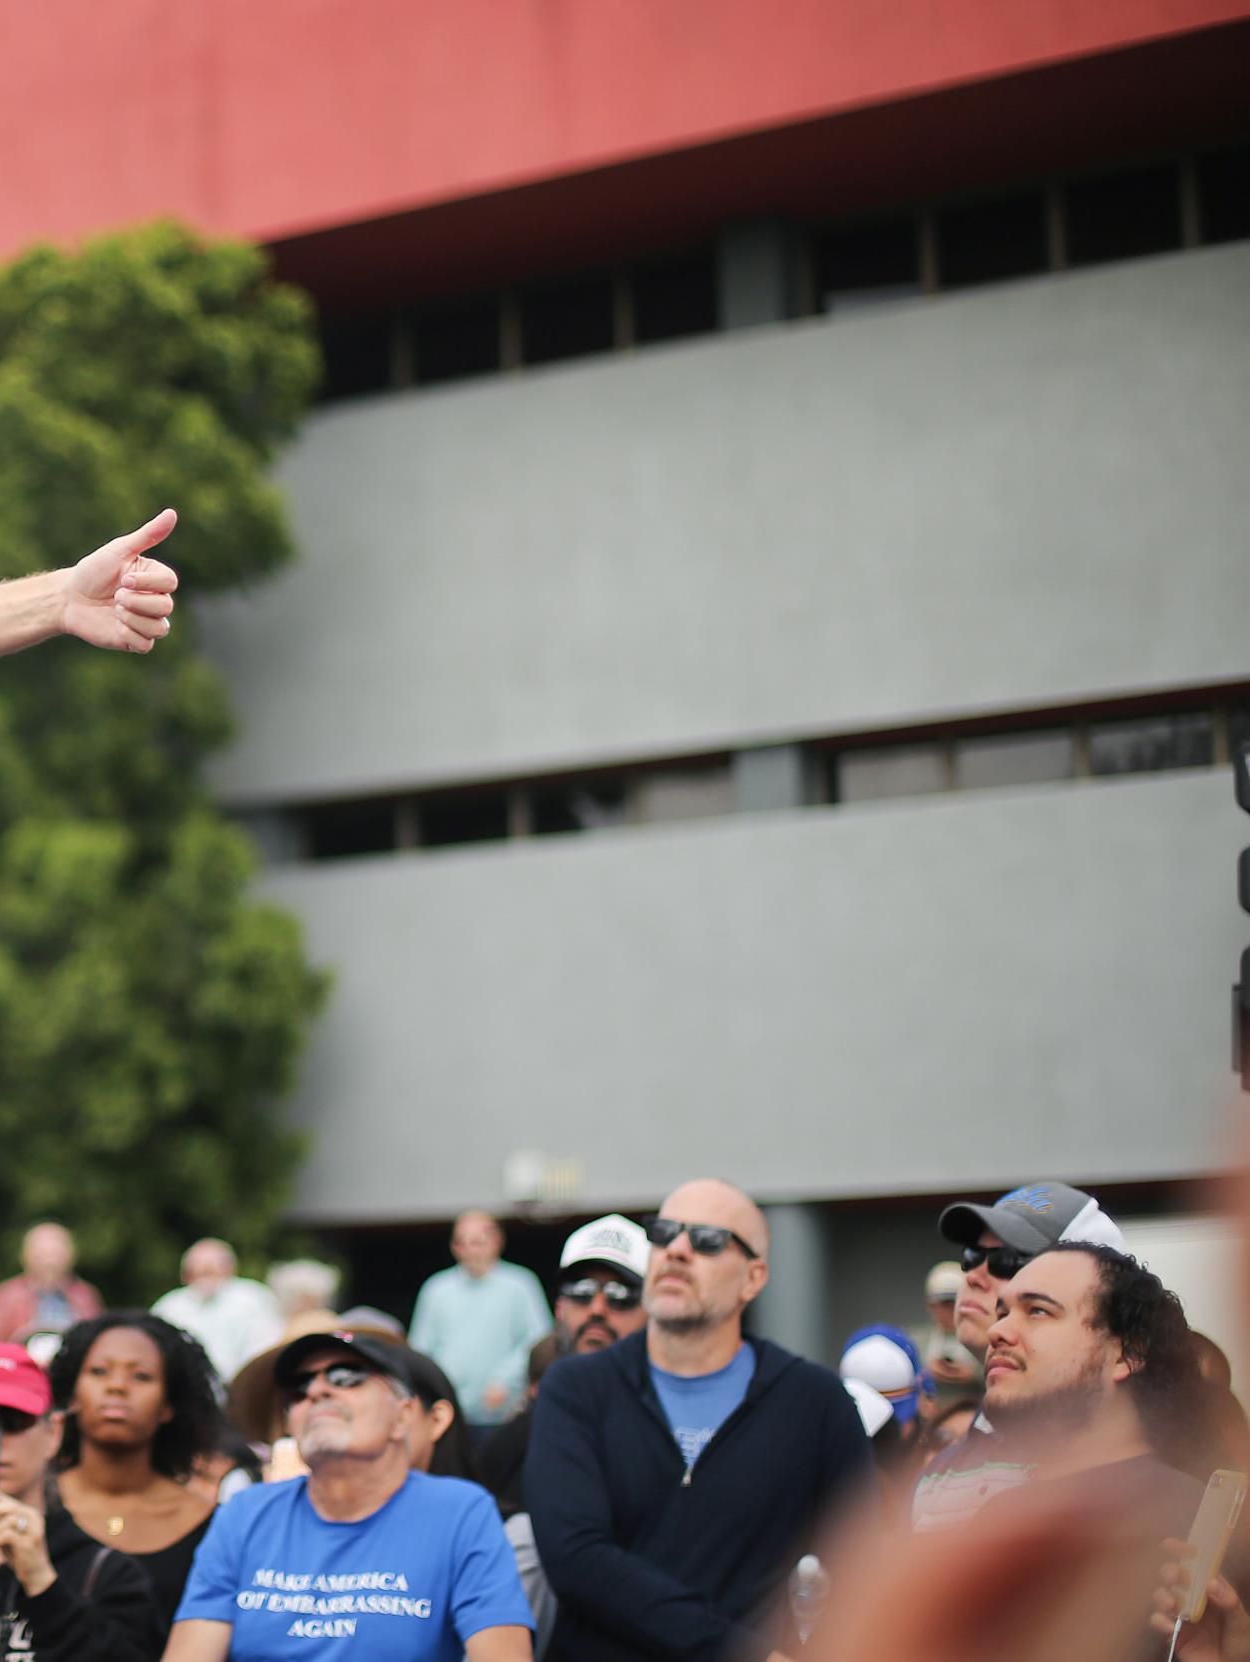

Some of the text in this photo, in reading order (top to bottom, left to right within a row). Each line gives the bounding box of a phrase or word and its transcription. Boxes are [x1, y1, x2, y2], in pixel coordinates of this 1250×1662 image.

[252, 1568, 409, 1593] MAKE AMERICA
[266, 1592, 432, 1619] EMBARRASSING
[287, 1618, 358, 1638] AGAIN
